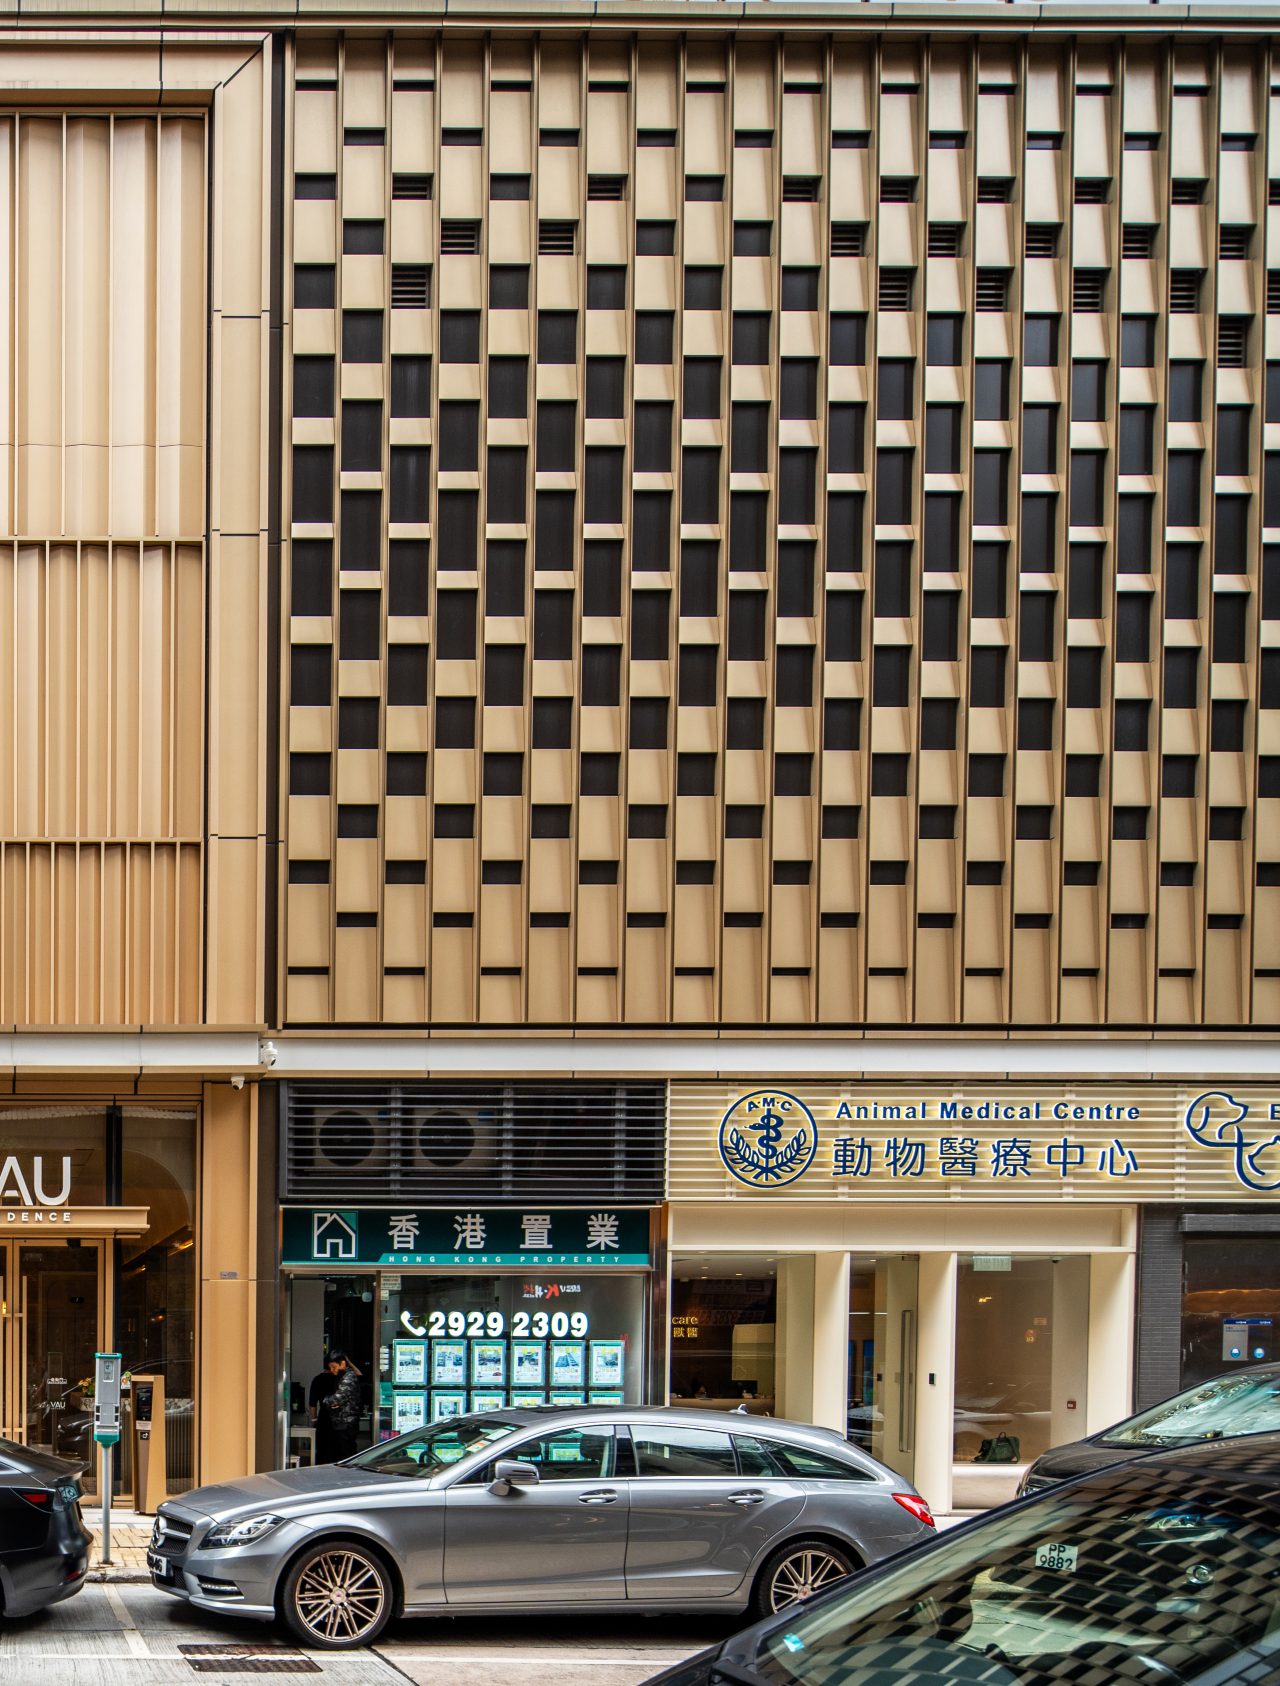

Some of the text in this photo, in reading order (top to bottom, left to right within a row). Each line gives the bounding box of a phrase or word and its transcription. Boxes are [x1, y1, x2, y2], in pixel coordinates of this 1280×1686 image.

[835, 1102, 1140, 1120] Animal Medical Centre
[831, 1136, 1139, 1177] 動物醫療中心
[387, 1213, 621, 1251] 香港置業
[388, 1255, 620, 1264] HONG KONG PROPERTY
[428, 1311, 589, 1338] 2929 2309
[1049, 1544, 1066, 1557] PP
[1040, 1554, 1073, 1571] 9882
